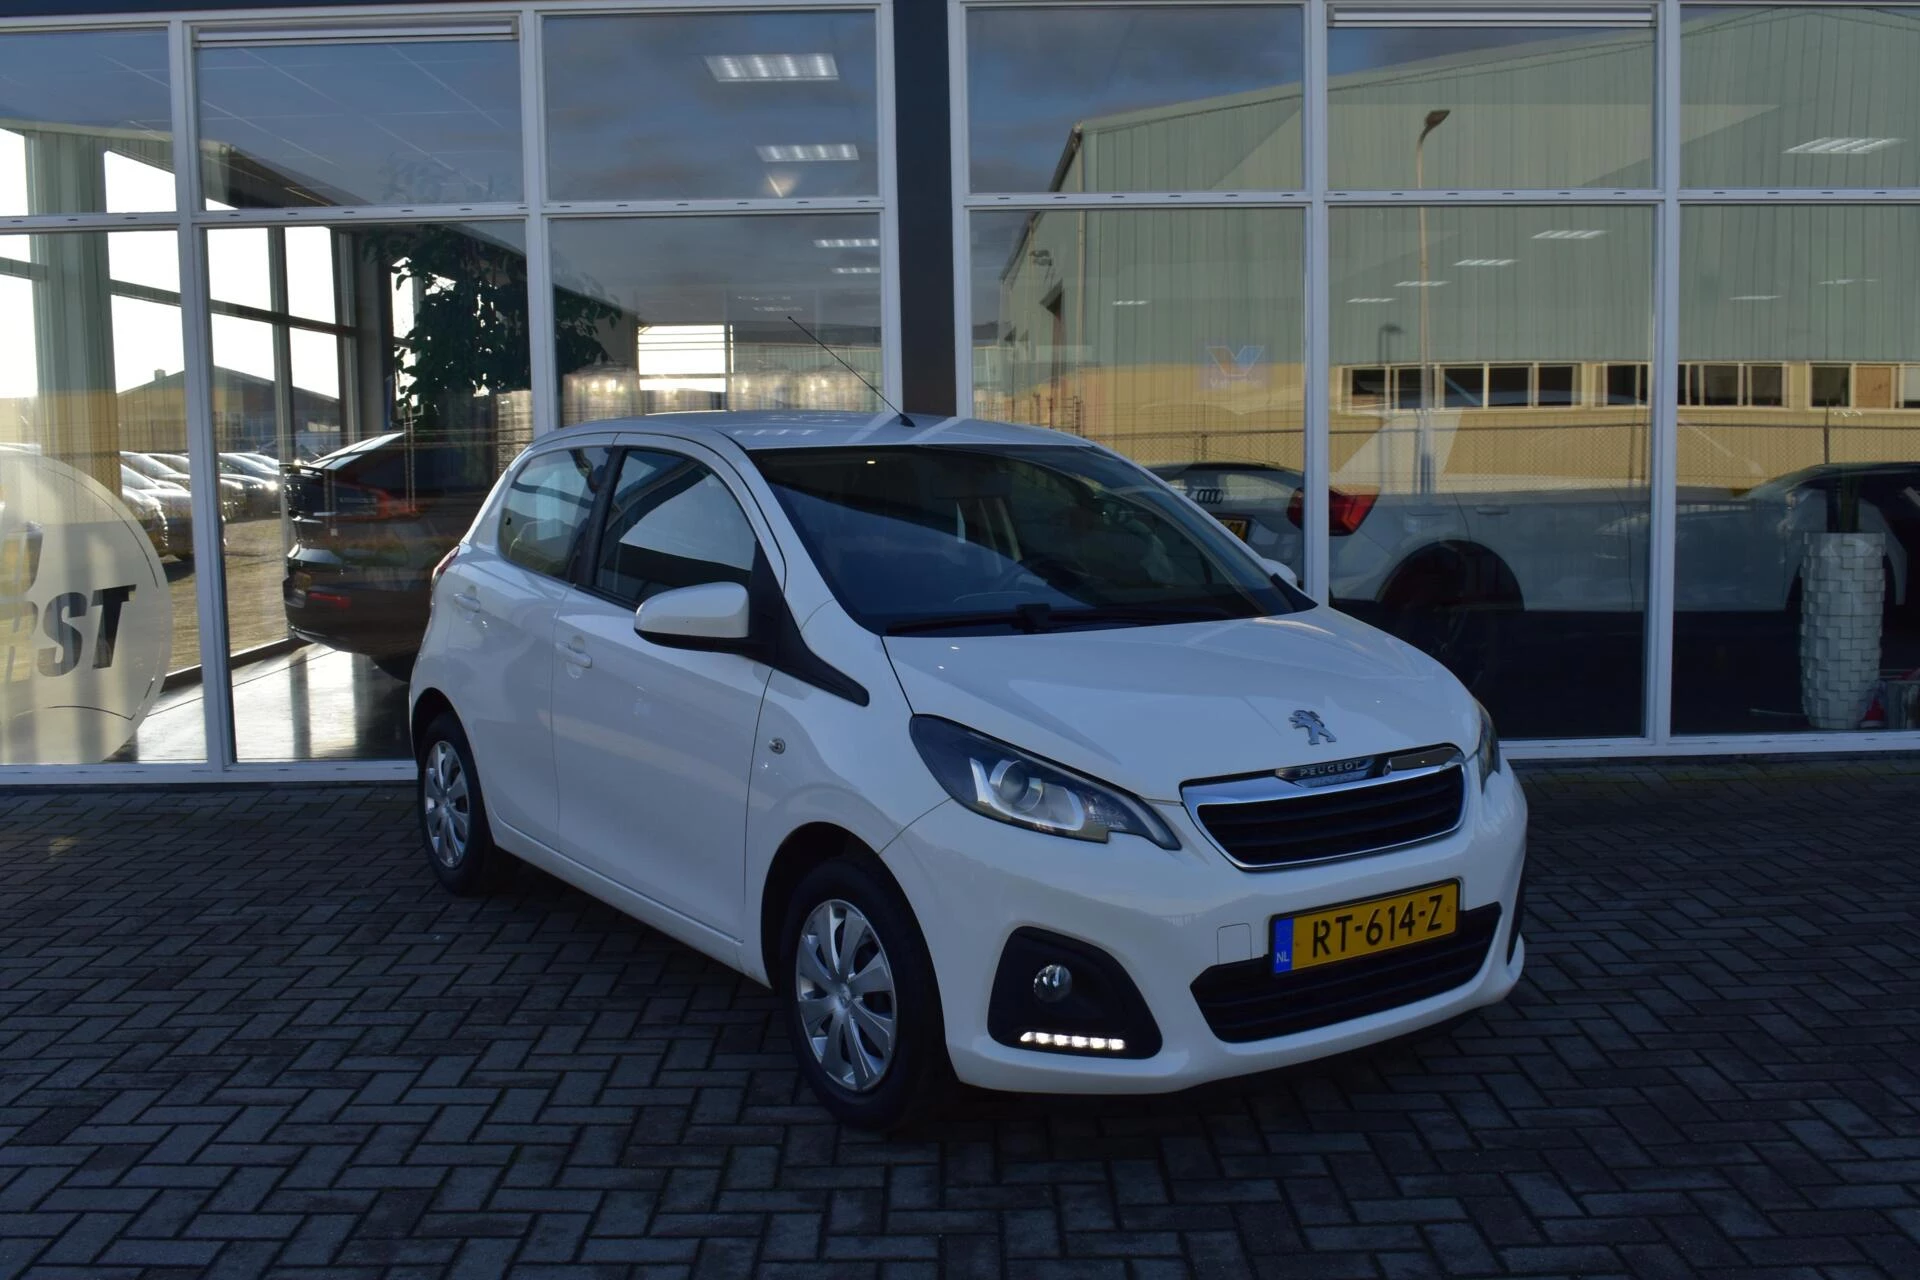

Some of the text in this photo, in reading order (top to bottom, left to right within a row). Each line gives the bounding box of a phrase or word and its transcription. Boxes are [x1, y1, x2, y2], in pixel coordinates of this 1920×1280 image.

[1300, 761, 1361, 777] PEUGEOT
[1312, 894, 1443, 958] RT-614-Z
[1276, 951, 1290, 965] NL
